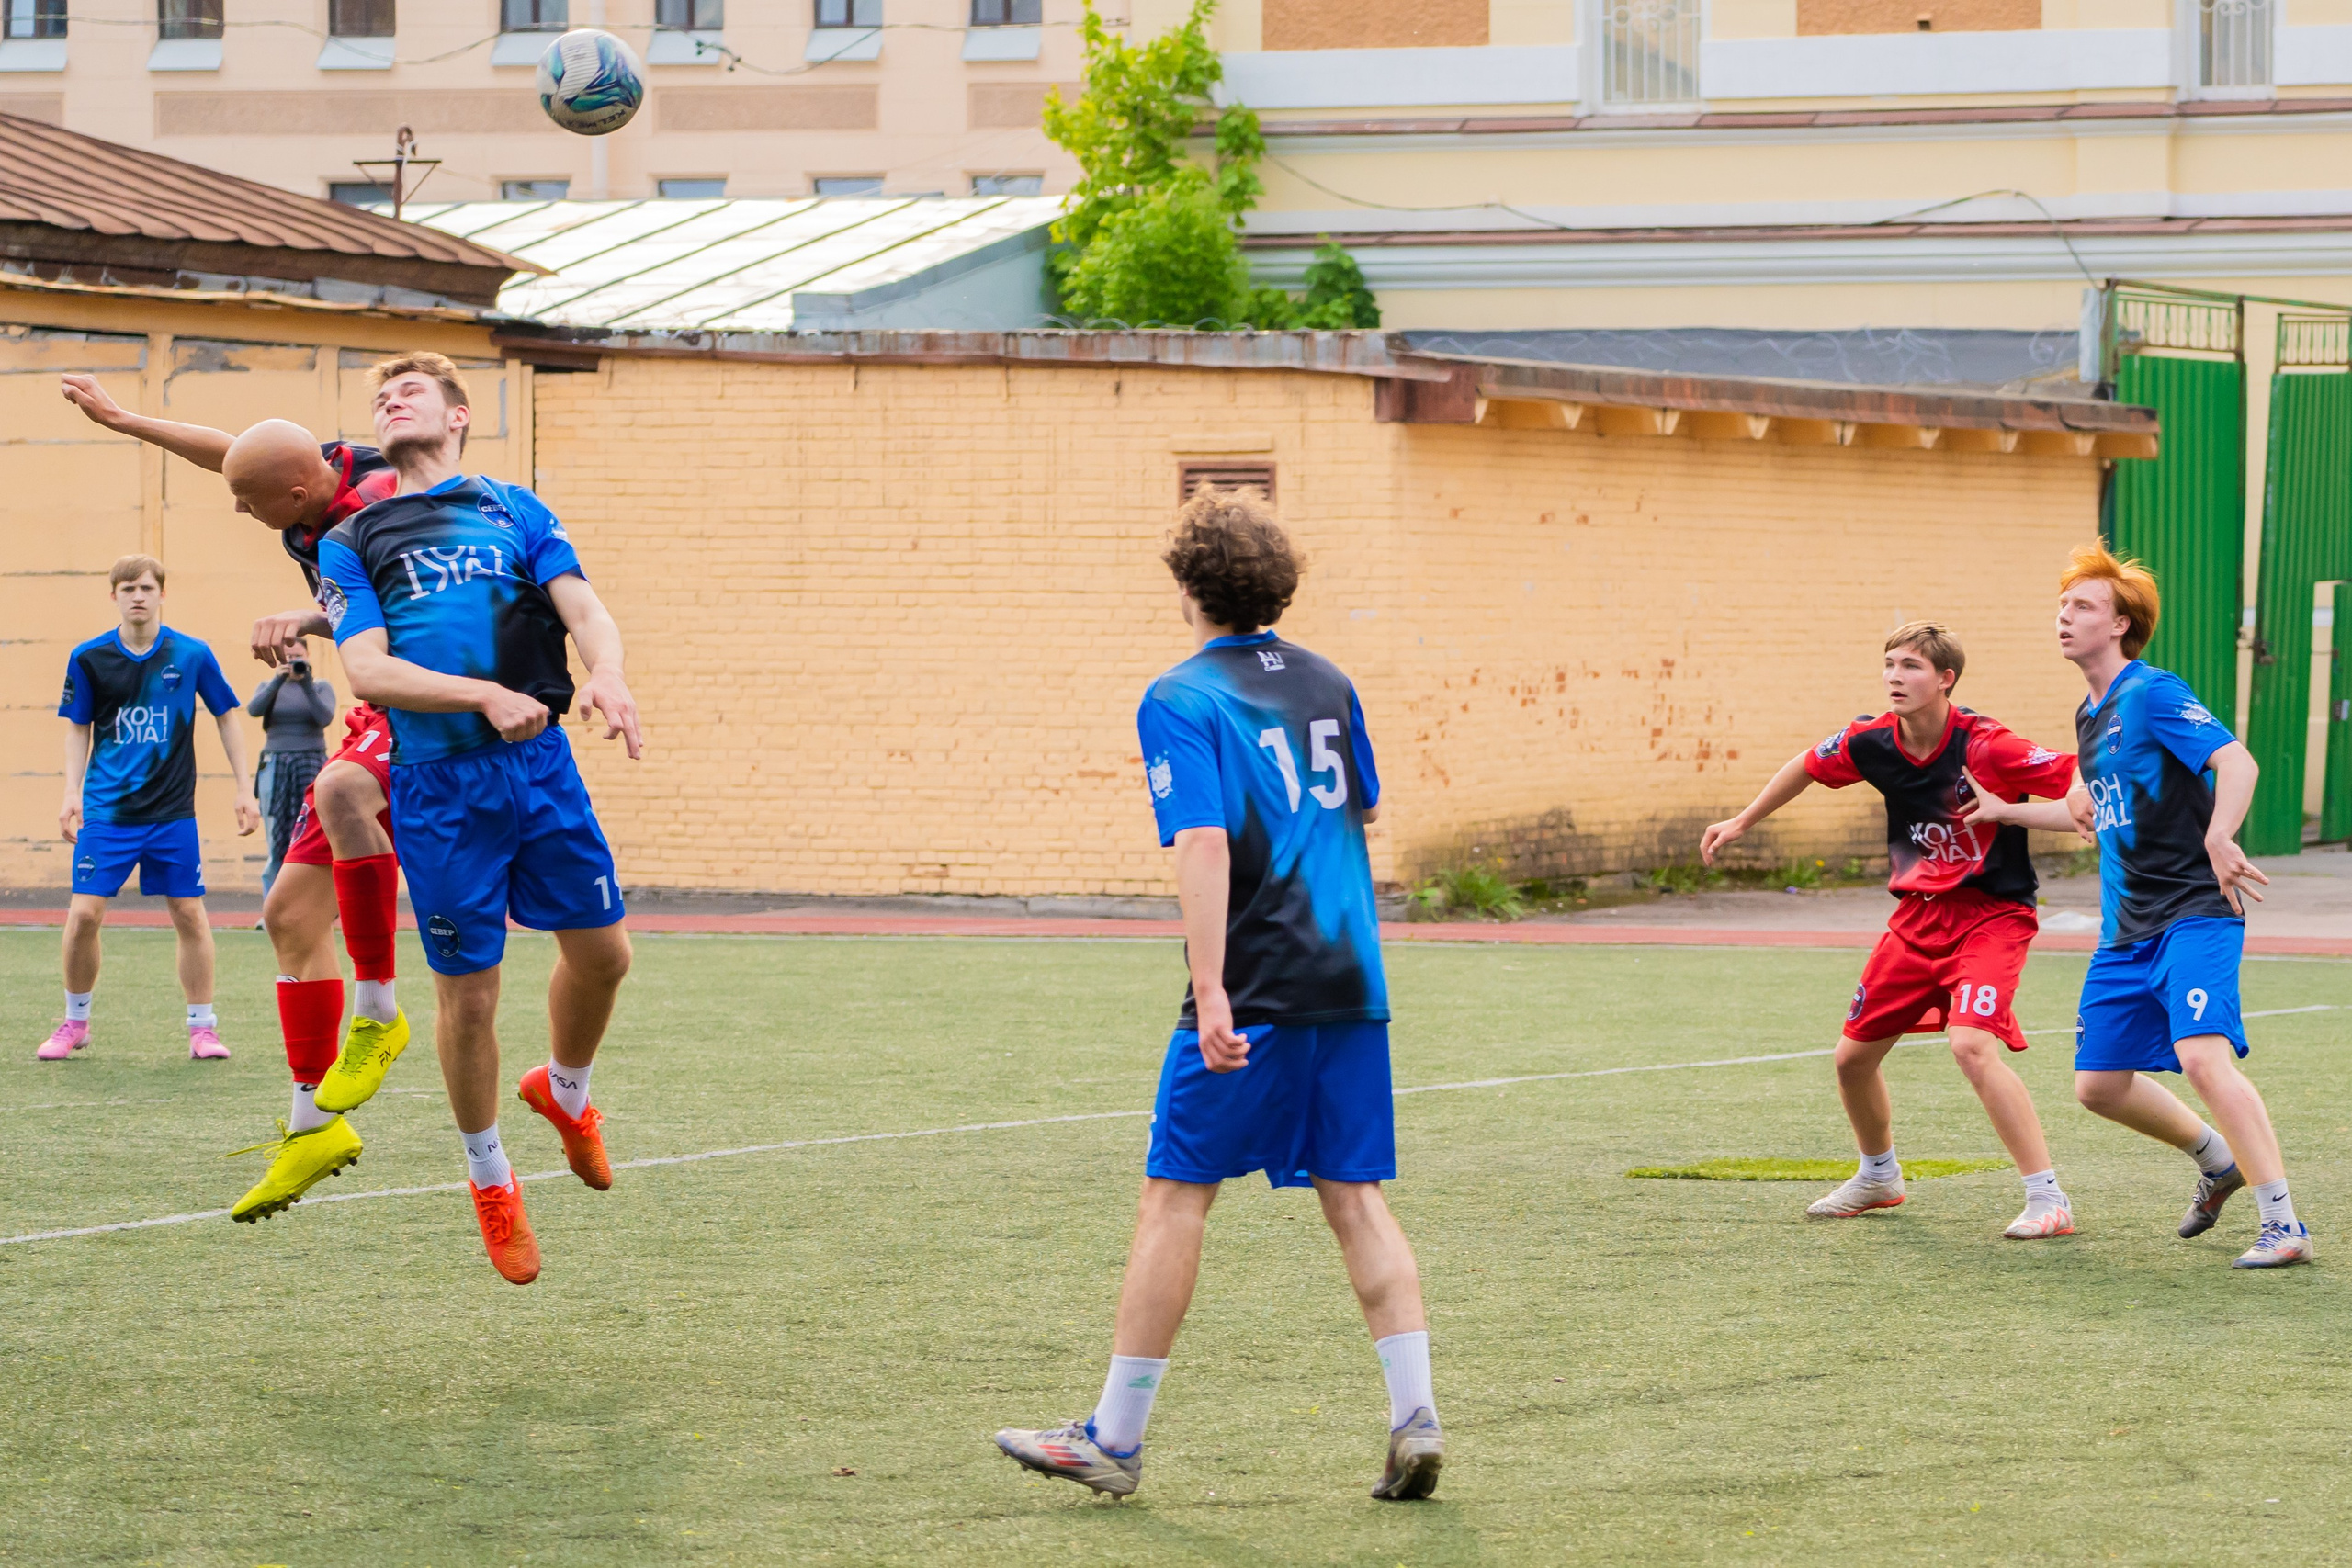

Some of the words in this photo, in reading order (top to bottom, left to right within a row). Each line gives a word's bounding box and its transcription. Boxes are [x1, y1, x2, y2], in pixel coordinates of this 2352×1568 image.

[1259, 718, 1348, 813] 15
[1959, 983, 1998, 1017] 18
[2186, 987, 2209, 1021] 9
